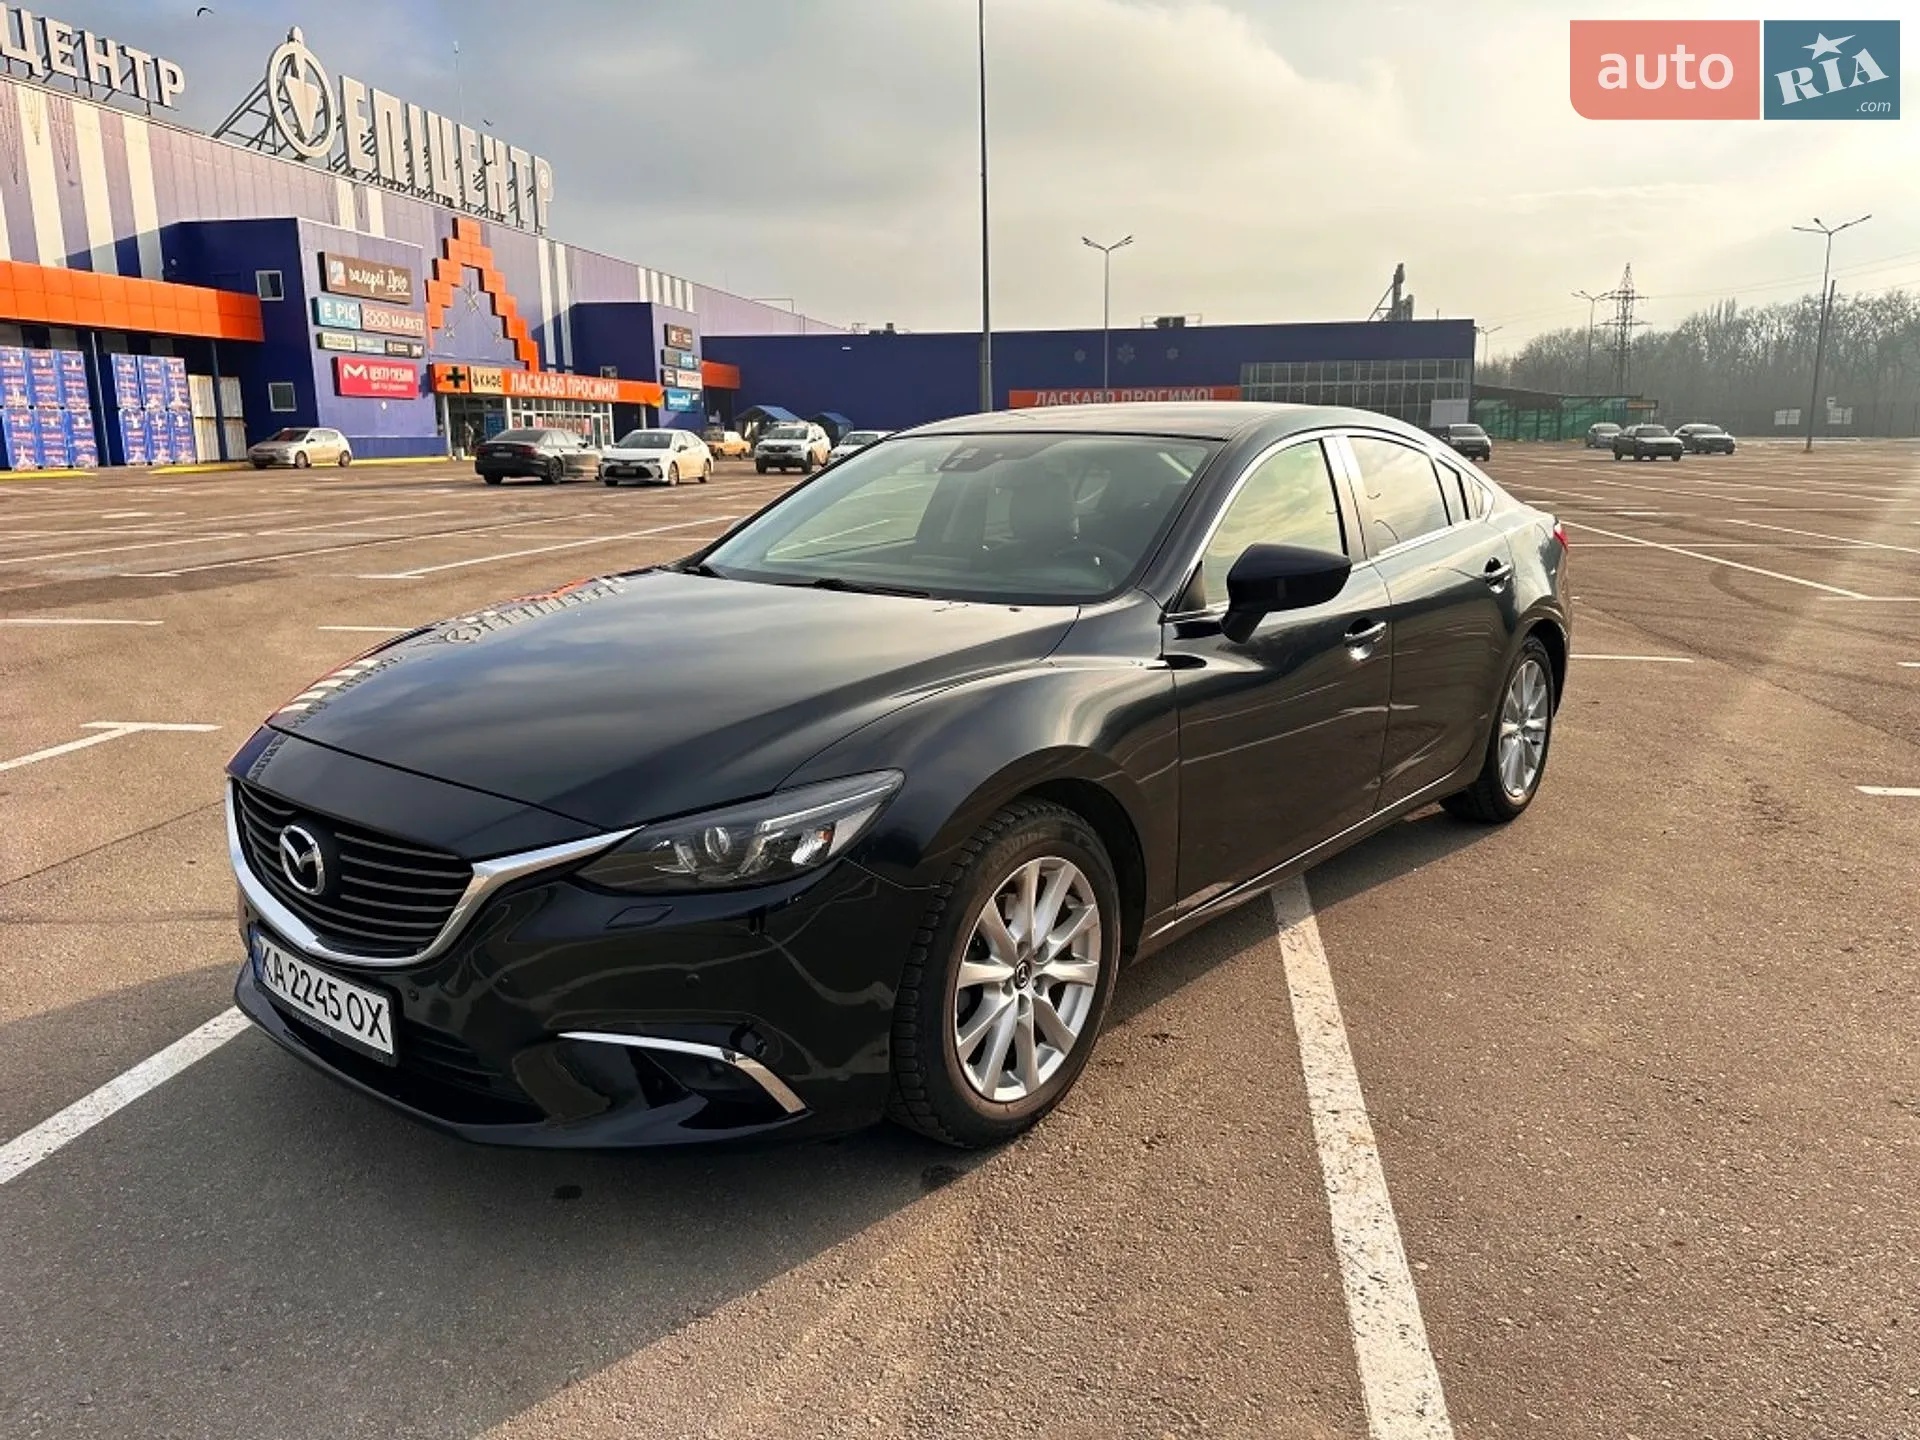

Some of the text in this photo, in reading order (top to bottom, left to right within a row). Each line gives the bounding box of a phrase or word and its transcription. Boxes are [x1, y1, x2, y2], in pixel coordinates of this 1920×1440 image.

[339, 75, 554, 229] ЕПІЦЕНТР
[479, 375, 502, 388] КАФЕ
[511, 373, 618, 400] ЛАСКАВО ПРОСИМО!
[1034, 390, 1116, 406] ЛАСКАВО
[262, 947, 288, 992] KA
[288, 962, 342, 1021] 2245
[346, 992, 388, 1044] OX
